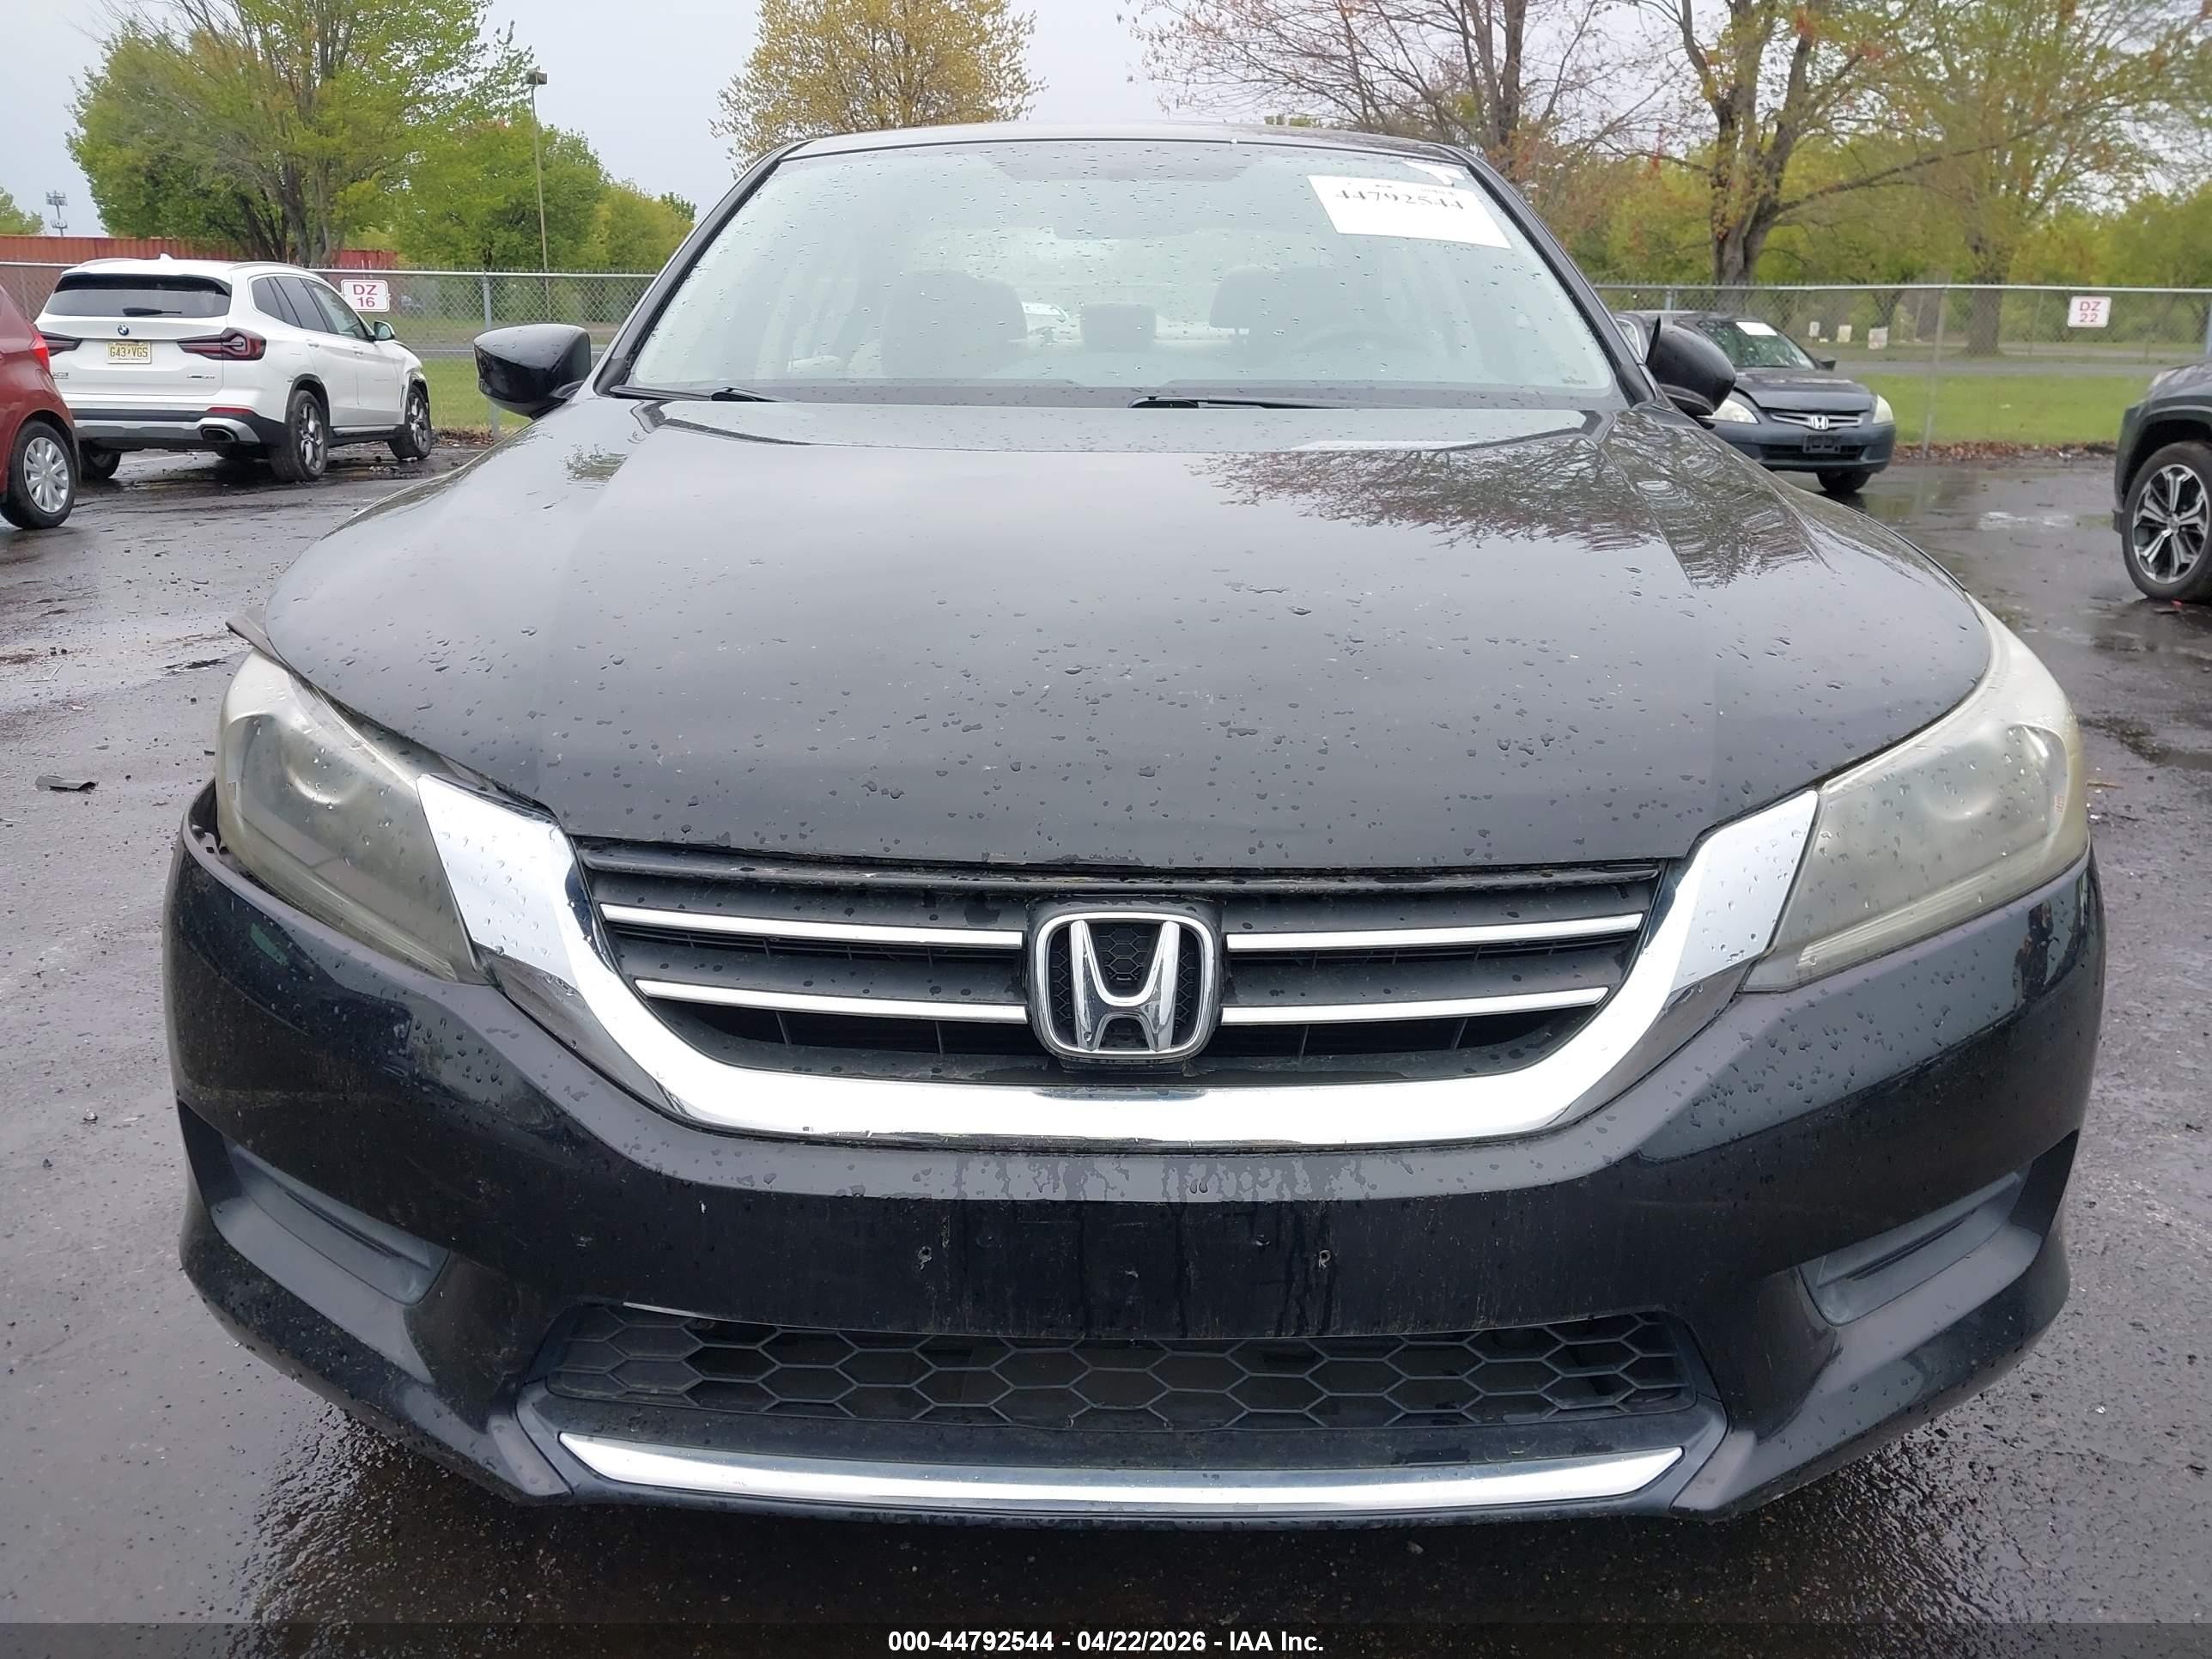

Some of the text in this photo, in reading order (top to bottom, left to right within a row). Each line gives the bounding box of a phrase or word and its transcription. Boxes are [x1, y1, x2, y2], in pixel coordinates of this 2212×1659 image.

[353, 284, 378, 295] DZ
[356, 296, 375, 307] 16
[2080, 301, 2101, 311] DZ
[2080, 313, 2099, 323] 22
